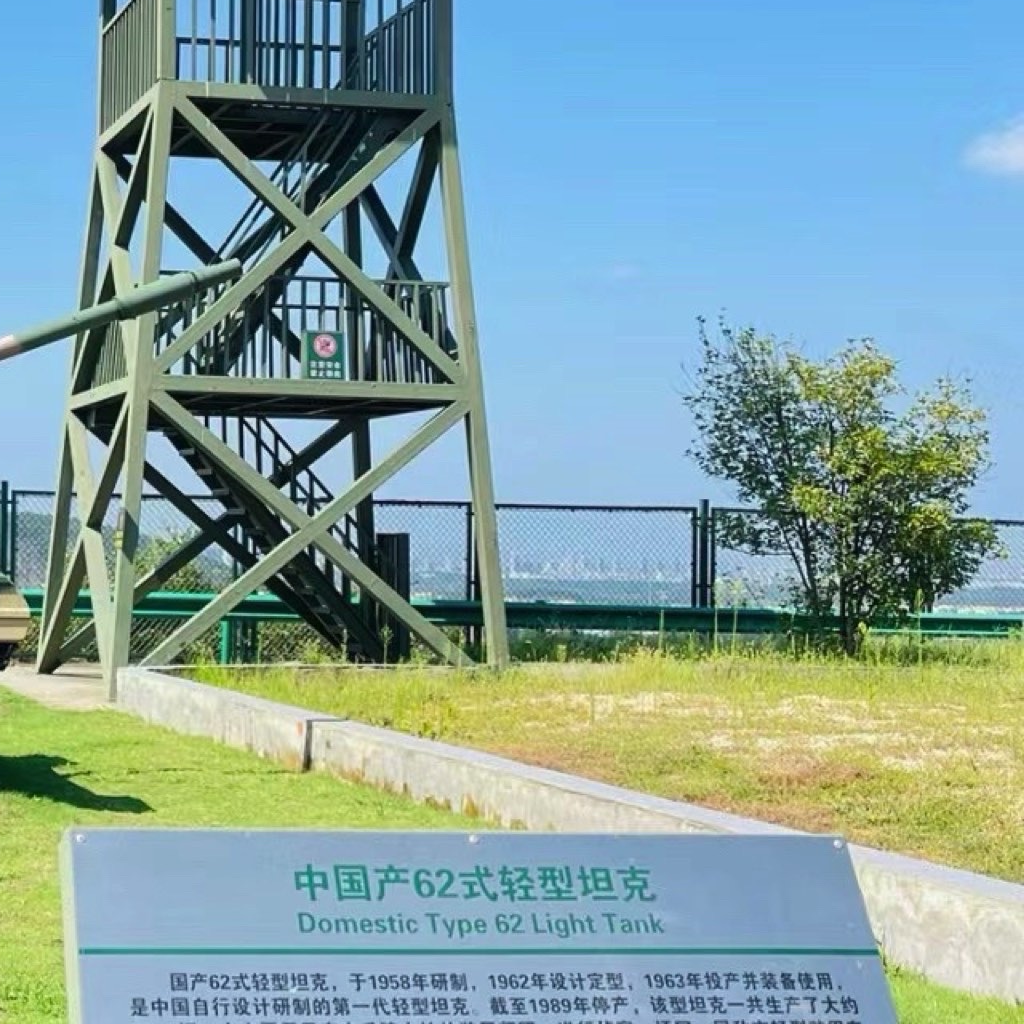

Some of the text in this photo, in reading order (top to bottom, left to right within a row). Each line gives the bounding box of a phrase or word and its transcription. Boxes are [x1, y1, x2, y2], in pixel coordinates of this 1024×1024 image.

[294, 863, 657, 902] 中国产62式轻型坦克
[297, 912, 665, 938] Domestic Type 62 Light Tank
